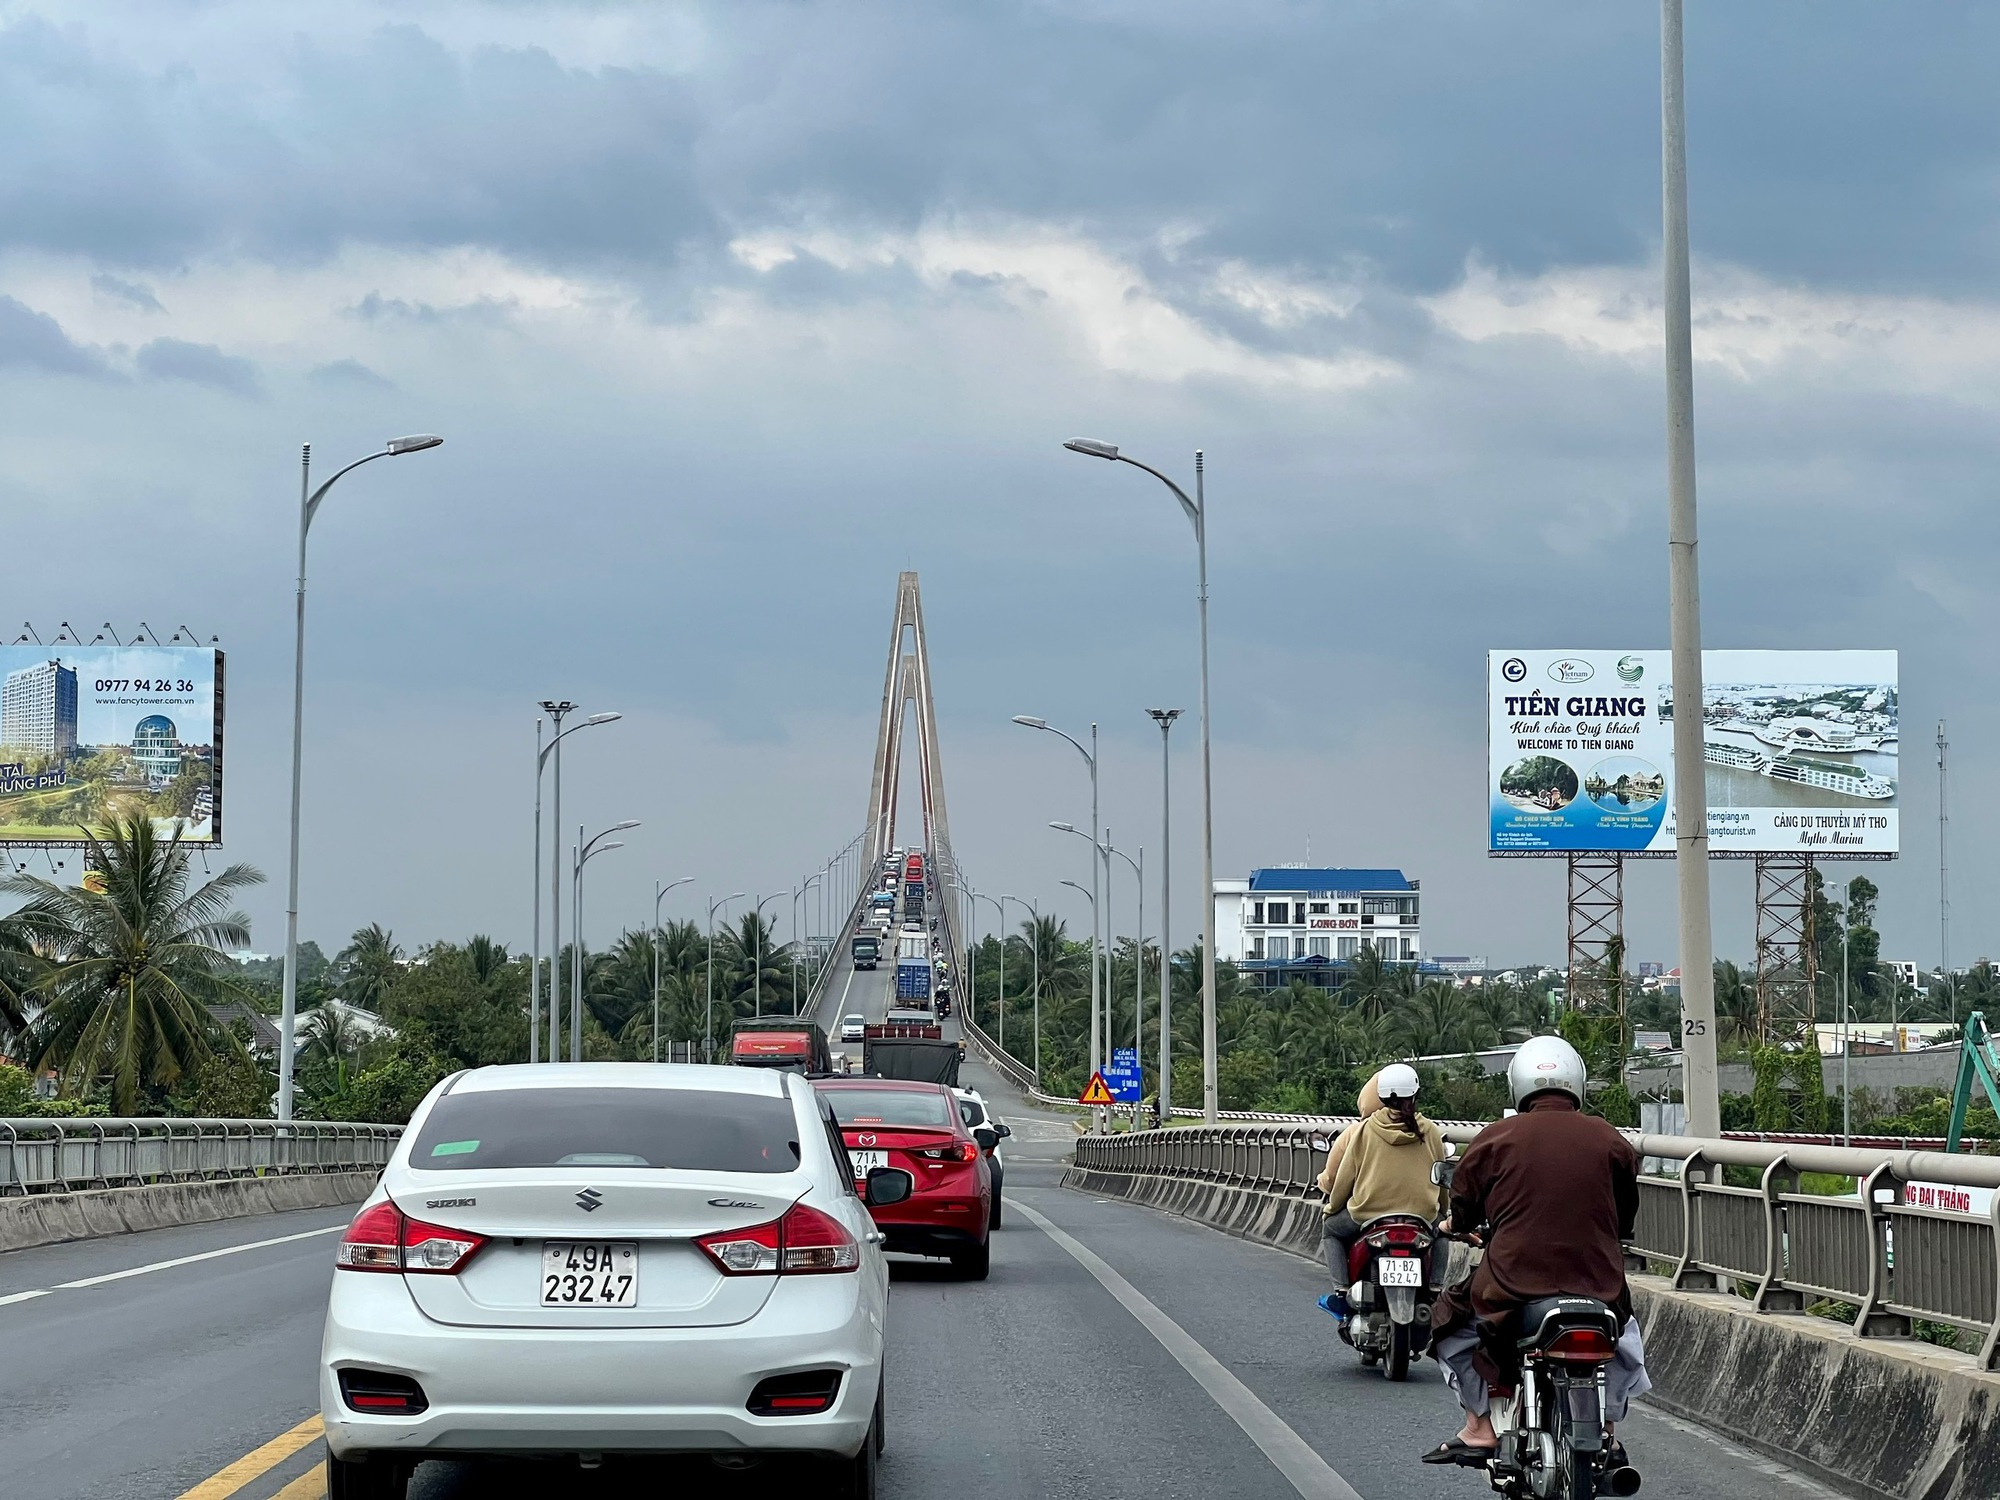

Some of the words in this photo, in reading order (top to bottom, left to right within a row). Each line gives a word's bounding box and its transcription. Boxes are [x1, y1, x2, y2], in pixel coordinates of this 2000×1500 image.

[95, 679, 129, 692] 0977
[134, 679, 150, 692] 94
[155, 679, 172, 692] 26
[176, 679, 194, 692] 36
[95, 697, 194, 706] www.fancytower.com.vn
[1505, 688, 1560, 716] TIỀN
[1566, 697, 1646, 716] GIANG
[1510, 720, 1541, 734] Kính
[1544, 721, 1572, 734] chào
[1576, 721, 1602, 737] Quý
[1605, 721, 1641, 734] khách
[1517, 739, 1563, 750] WELCOME
[1566, 740, 1578, 750] TO
[1582, 740, 1601, 750] TIEN
[1605, 740, 1634, 750] GIANG
[39, 771, 67, 788] PHÚ
[1774, 811, 1799, 828] CẢNG
[1801, 815, 1813, 828] DU
[1868, 816, 1887, 828] THO
[1797, 830, 1828, 846] Mytho
[1829, 831, 1864, 845] Marina
[1310, 920, 1337, 929] LONG
[1338, 918, 1358, 929] SƠN
[1685, 1019, 1706, 1036] 25
[857, 1152, 878, 1164] 71A
[426, 1198, 476, 1209] SUZUKI
[566, 1245, 613, 1272] 49A
